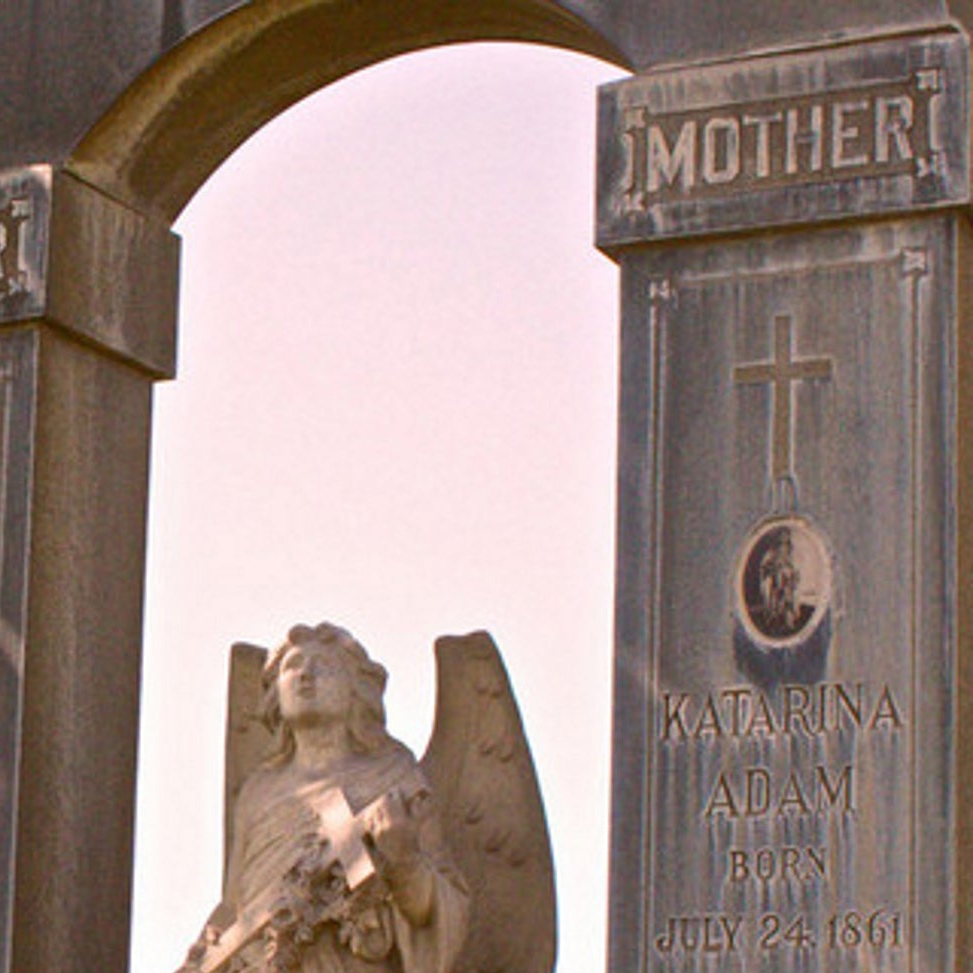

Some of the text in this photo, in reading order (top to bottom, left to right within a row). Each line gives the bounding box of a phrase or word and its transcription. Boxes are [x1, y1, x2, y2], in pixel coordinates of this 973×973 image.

[646, 96, 915, 193] MOTHER
[661, 683, 903, 741] KATARINA
[704, 765, 855, 818] ADAM
[729, 848, 826, 882] BORN
[656, 914, 744, 952] JULY
[828, 909, 902, 949] 1861
